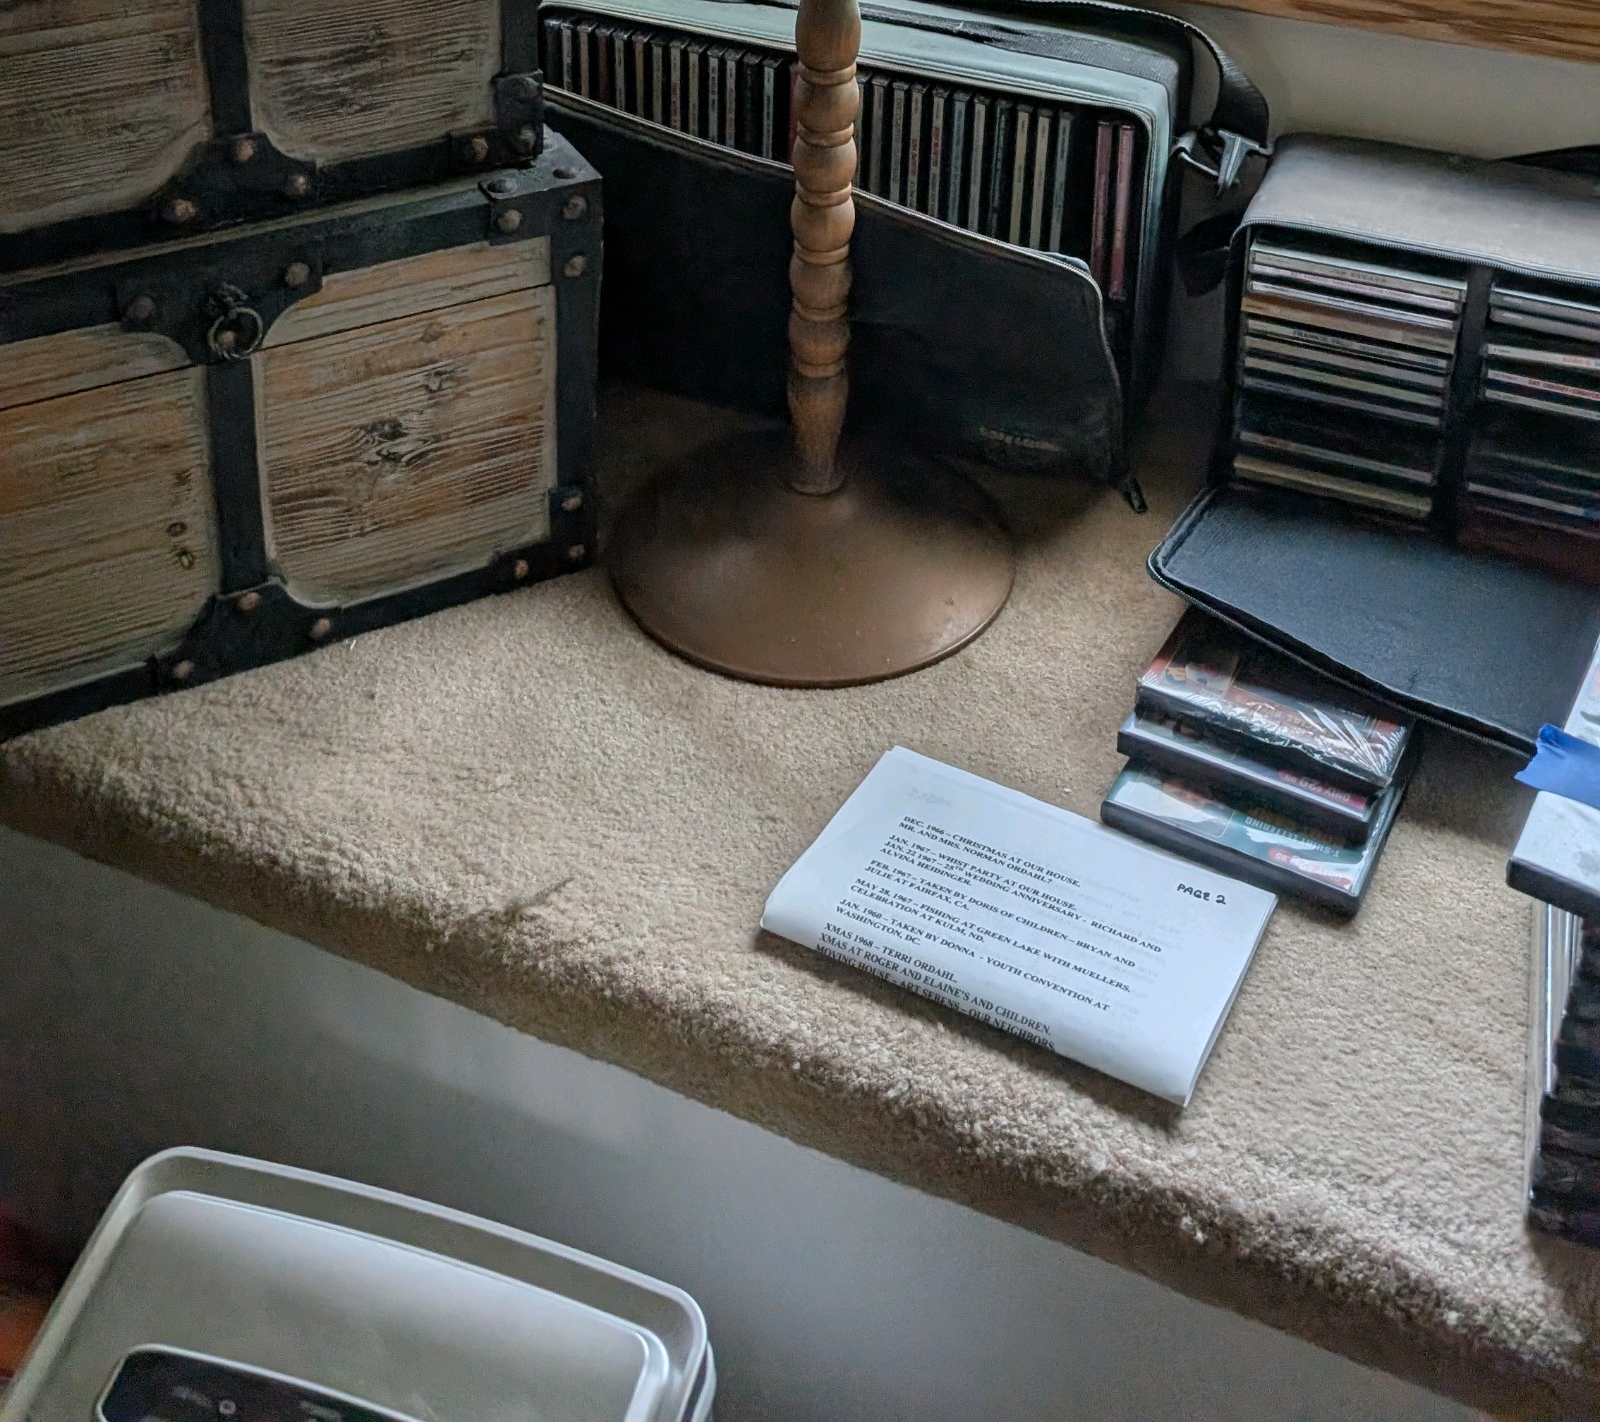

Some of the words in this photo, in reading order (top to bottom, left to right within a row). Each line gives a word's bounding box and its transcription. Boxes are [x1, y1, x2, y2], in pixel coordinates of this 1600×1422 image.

[880, 847, 915, 865] ALVINA
[916, 861, 972, 886] HEIDINGER.
[889, 834, 908, 846] JAN.
[911, 842, 930, 854] 1967
[938, 853, 970, 868] WHIST
[970, 865, 1002, 881] PARTY
[1002, 878, 1018, 887] AT
[1018, 884, 1040, 896] OUR
[1041, 892, 1077, 910] HOUSE.
[899, 822, 916, 832] MR.
[917, 830, 938, 841] AND
[938, 837, 960, 850] MRS.
[962, 846, 1007, 866] NORMAN
[1006, 863, 1052, 884] ORDAHL?
[903, 816, 924, 828] DEC.
[926, 824, 945, 835] 1966
[952, 834, 1007, 858] CHRISTMAS
[1008, 856, 1022, 864] AT
[1023, 861, 1044, 873] OUR
[1046, 869, 1080, 887] HOUSE.
[850, 885, 919, 916] CELEBRATION
[919, 912, 934, 921] AT
[968, 931, 985, 942] ND.
[864, 866, 894, 881] JULIE
[894, 877, 911, 885] AT
[954, 900, 970, 910] CA.
[870, 859, 890, 872] FEB.
[892, 867, 912, 879] 1967
[920, 878, 953, 894] TAKEN
[953, 891, 968, 900] BY
[968, 897, 999, 912] DORIS
[1000, 909, 1015, 918] OF
[1016, 916, 1068, 940] CHILDREN
[1076, 940, 1112, 958] BRYAN
[1113, 955, 1136, 968] AND
[884, 841, 903, 852] JAN.
[906, 849, 916, 858] 22
[918, 854, 937, 865] 1967
[964, 870, 1011, 893] WEDDING
[1011, 890, 1082, 921] ANNIVERSARY
[1090, 920, 1138, 943] RICHARD
[1139, 941, 1162, 953] AND
[1177, 883, 1210, 901] PAGE
[1215, 894, 1226, 905] 2
[824, 922, 853, 939] XMAS
[854, 934, 874, 947] 1968
[882, 946, 912, 964] TERRI
[914, 959, 958, 983] ORDAHL.
[836, 906, 902, 939] WASHINGTON,
[904, 934, 921, 945] DC.
[840, 899, 860, 911] JAN.
[890, 918, 924, 936] TAKEN
[925, 932, 940, 942] BY
[940, 939, 975, 958] DONNA
[986, 957, 1022, 976] YOUTH
[1023, 972, 1093, 1004] CONVENTION
[1093, 1002, 1110, 1011] AT
[855, 878, 879, 890] MAY
[878, 887, 890, 896] 28,
[893, 892, 912, 904] 1967
[919, 903, 960, 924] FISHING
[960, 920, 976, 928] AT
[976, 926, 1012, 945] GREEN
[1013, 940, 1041, 956] LAKE
[1042, 952, 1071, 968] WITH
[1072, 964, 1131, 992] MUELLERS.
[819, 932, 848, 950] XMAS
[848, 946, 863, 956] AT
[864, 951, 900, 972] ROGER
[900, 968, 922, 981] AND
[970, 996, 994, 1011] AND
[995, 1006, 1051, 1035] CHILDREN.
[858, 962, 890, 979] HOUSE
[968, 1009, 991, 1024] OUR
